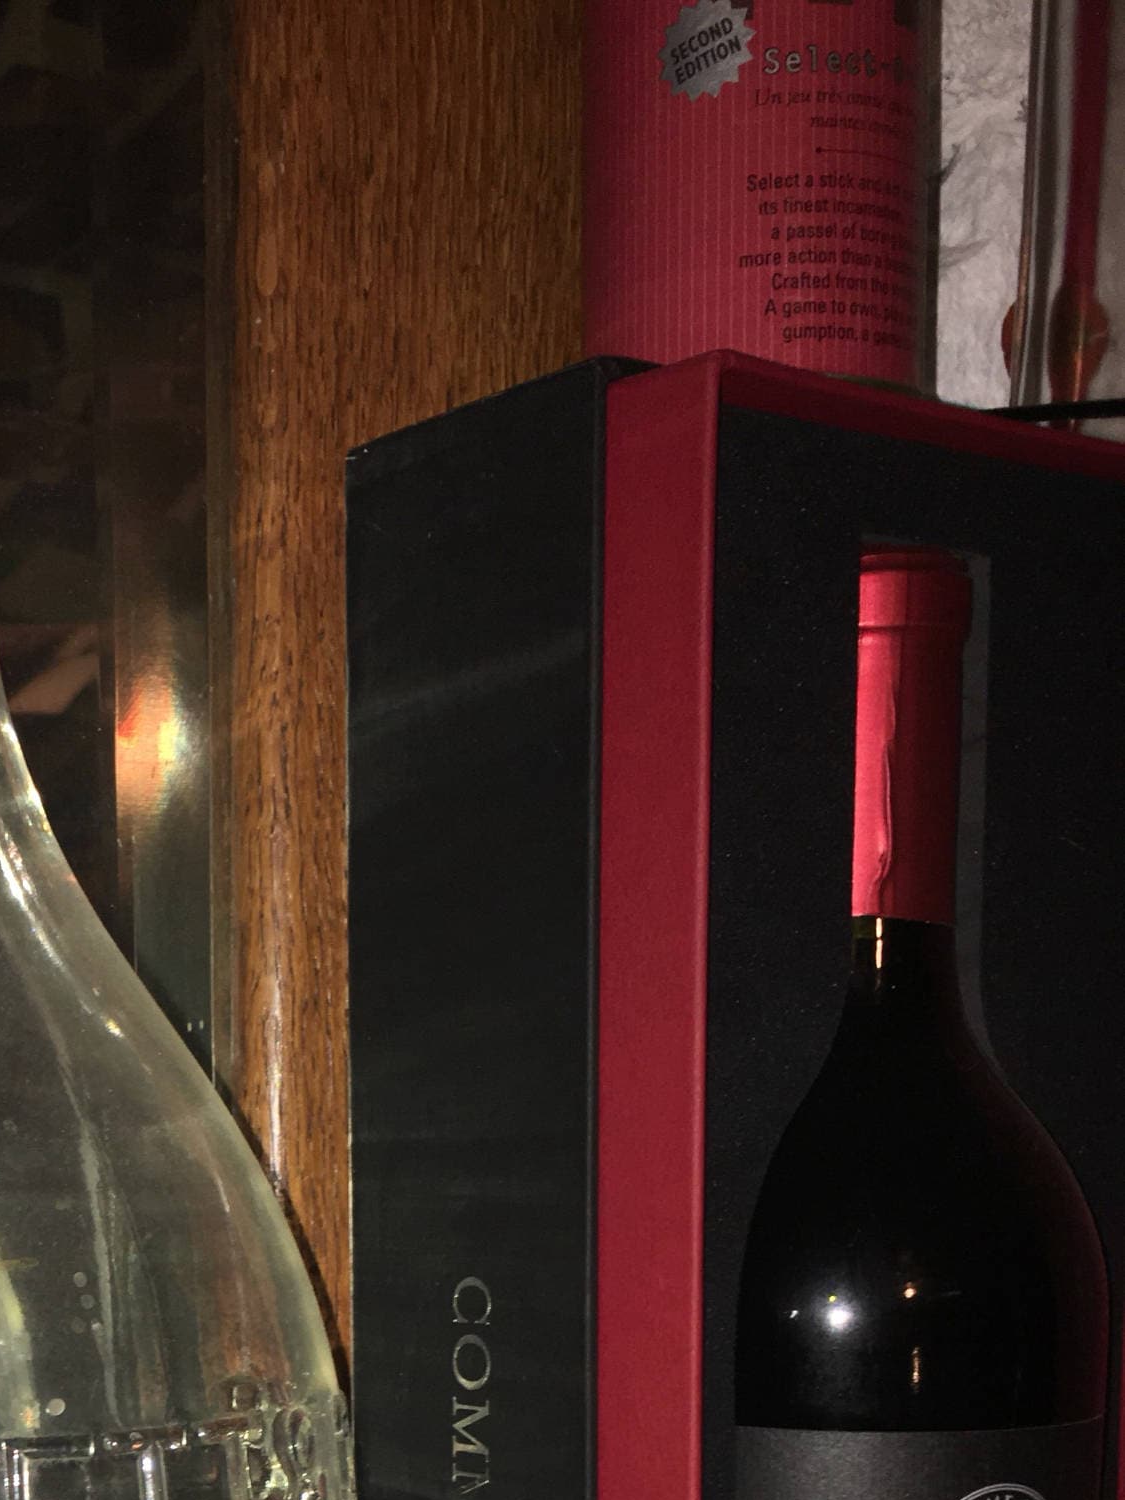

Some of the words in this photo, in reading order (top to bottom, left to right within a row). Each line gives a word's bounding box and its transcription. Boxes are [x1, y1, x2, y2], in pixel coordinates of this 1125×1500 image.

[671, 17, 734, 65] SECOND
[675, 35, 742, 86] EDITION
[746, 173, 800, 192] Select
[804, 174, 814, 188] a
[820, 171, 854, 188] stick
[758, 201, 778, 216] its
[783, 198, 829, 215] finest
[770, 225, 780, 240] a
[786, 222, 837, 242] passel
[739, 251, 782, 268] more
[787, 247, 837, 264] action
[771, 271, 830, 291] Crafted
[835, 273, 868, 291] from
[764, 298, 777, 316] A
[782, 300, 826, 318] game
[831, 298, 846, 315] to
[782, 323, 859, 344] gumption,
